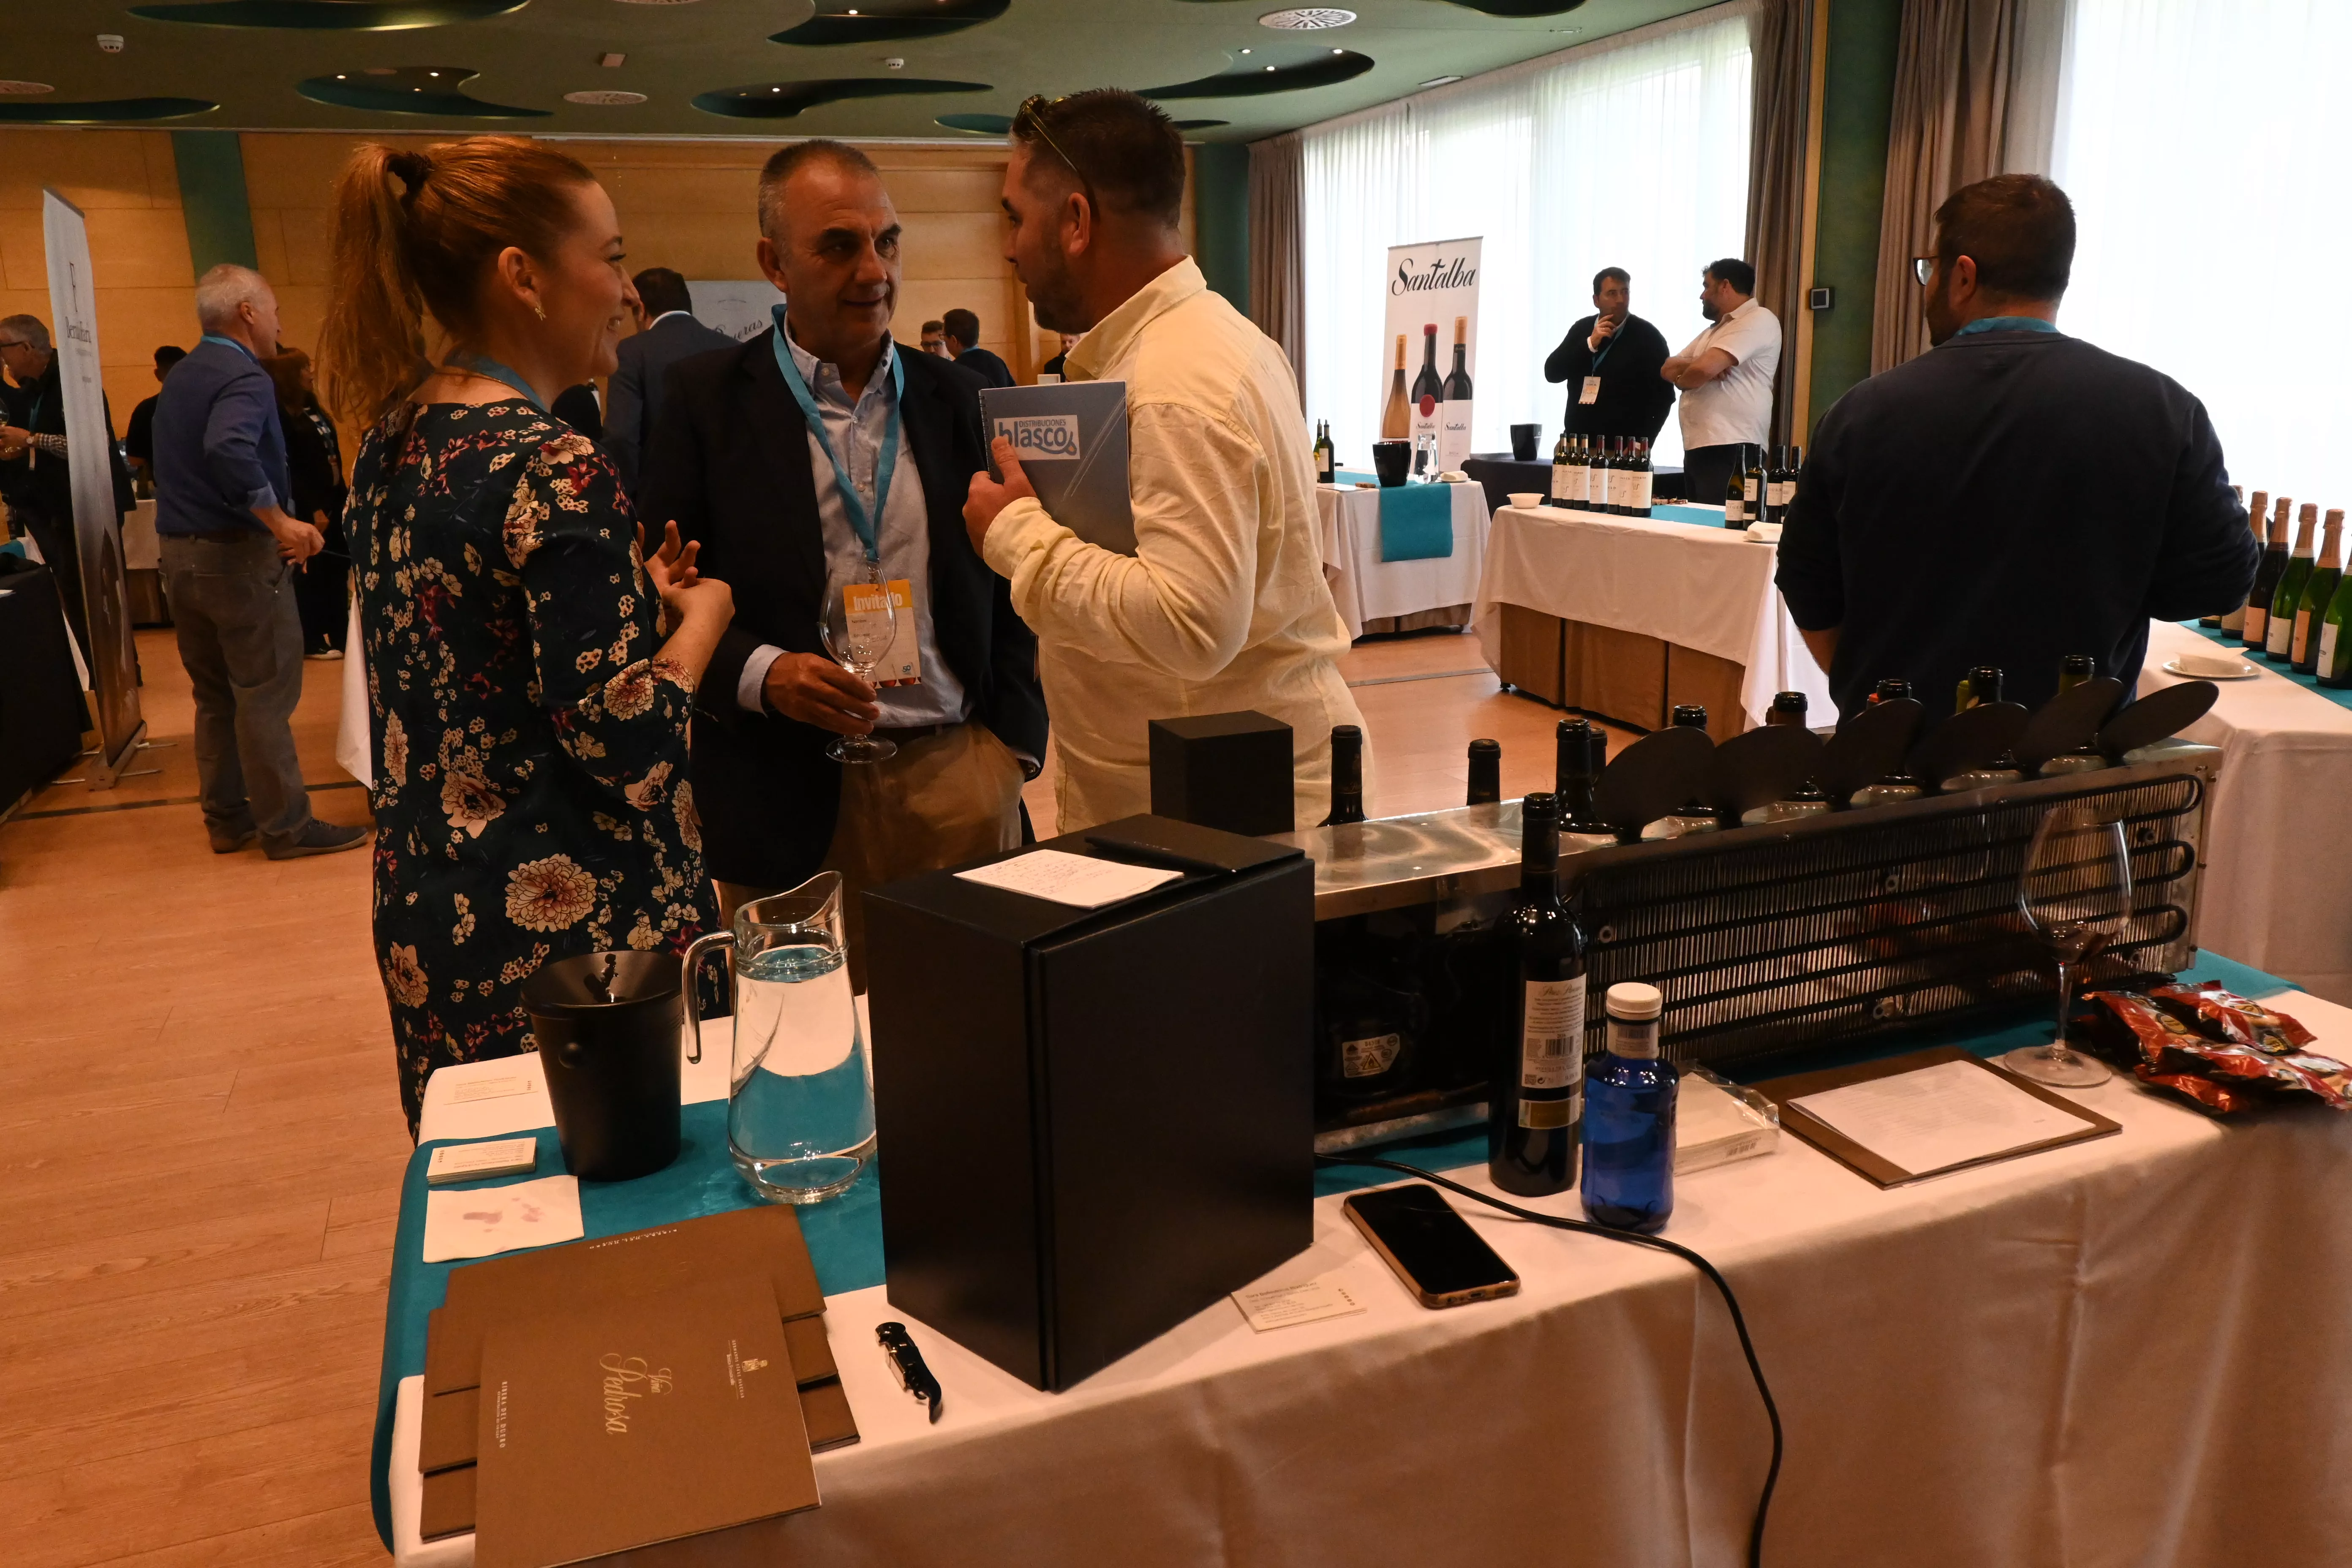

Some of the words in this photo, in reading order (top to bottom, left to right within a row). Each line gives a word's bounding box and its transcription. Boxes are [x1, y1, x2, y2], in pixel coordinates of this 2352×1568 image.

[1391, 257, 1476, 296] Santalba
[999, 421, 1071, 451] blasco
[1019, 419, 1066, 427] DISTRIBUCIONES
[1445, 422, 1467, 431] Santalba
[600, 1353, 648, 1435] Pedrosa
